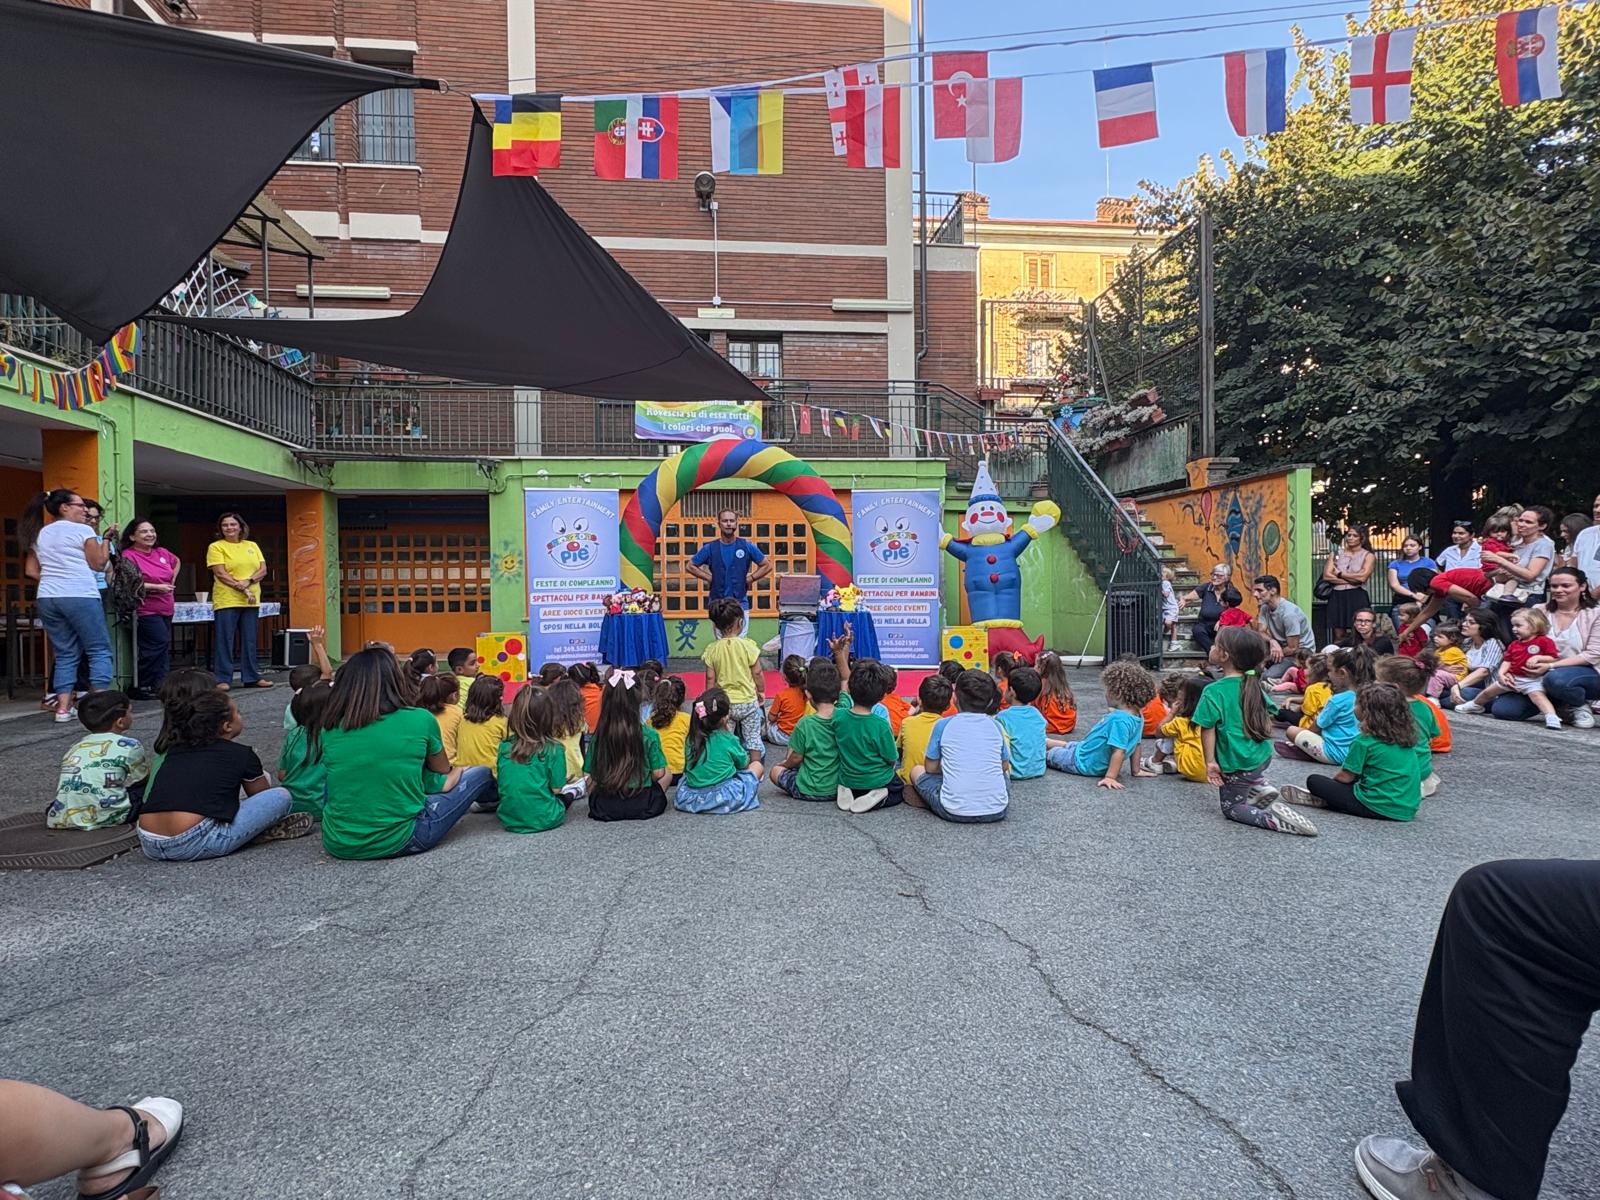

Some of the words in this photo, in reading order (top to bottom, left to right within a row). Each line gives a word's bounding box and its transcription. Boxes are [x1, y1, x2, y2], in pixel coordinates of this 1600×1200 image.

[646, 408, 684, 417] Rovescia
[698, 410, 708, 418] di
[709, 412, 726, 420] essa
[728, 412, 750, 420] tutti
[668, 422, 694, 432] colori
[696, 424, 711, 433] che
[712, 425, 736, 434] puoi.
[530, 501, 555, 519] FAMILY
[557, 496, 615, 520] ENTERTAINMENT
[856, 501, 878, 519] FAMILY
[880, 496, 936, 518] ENTERTAINMENT
